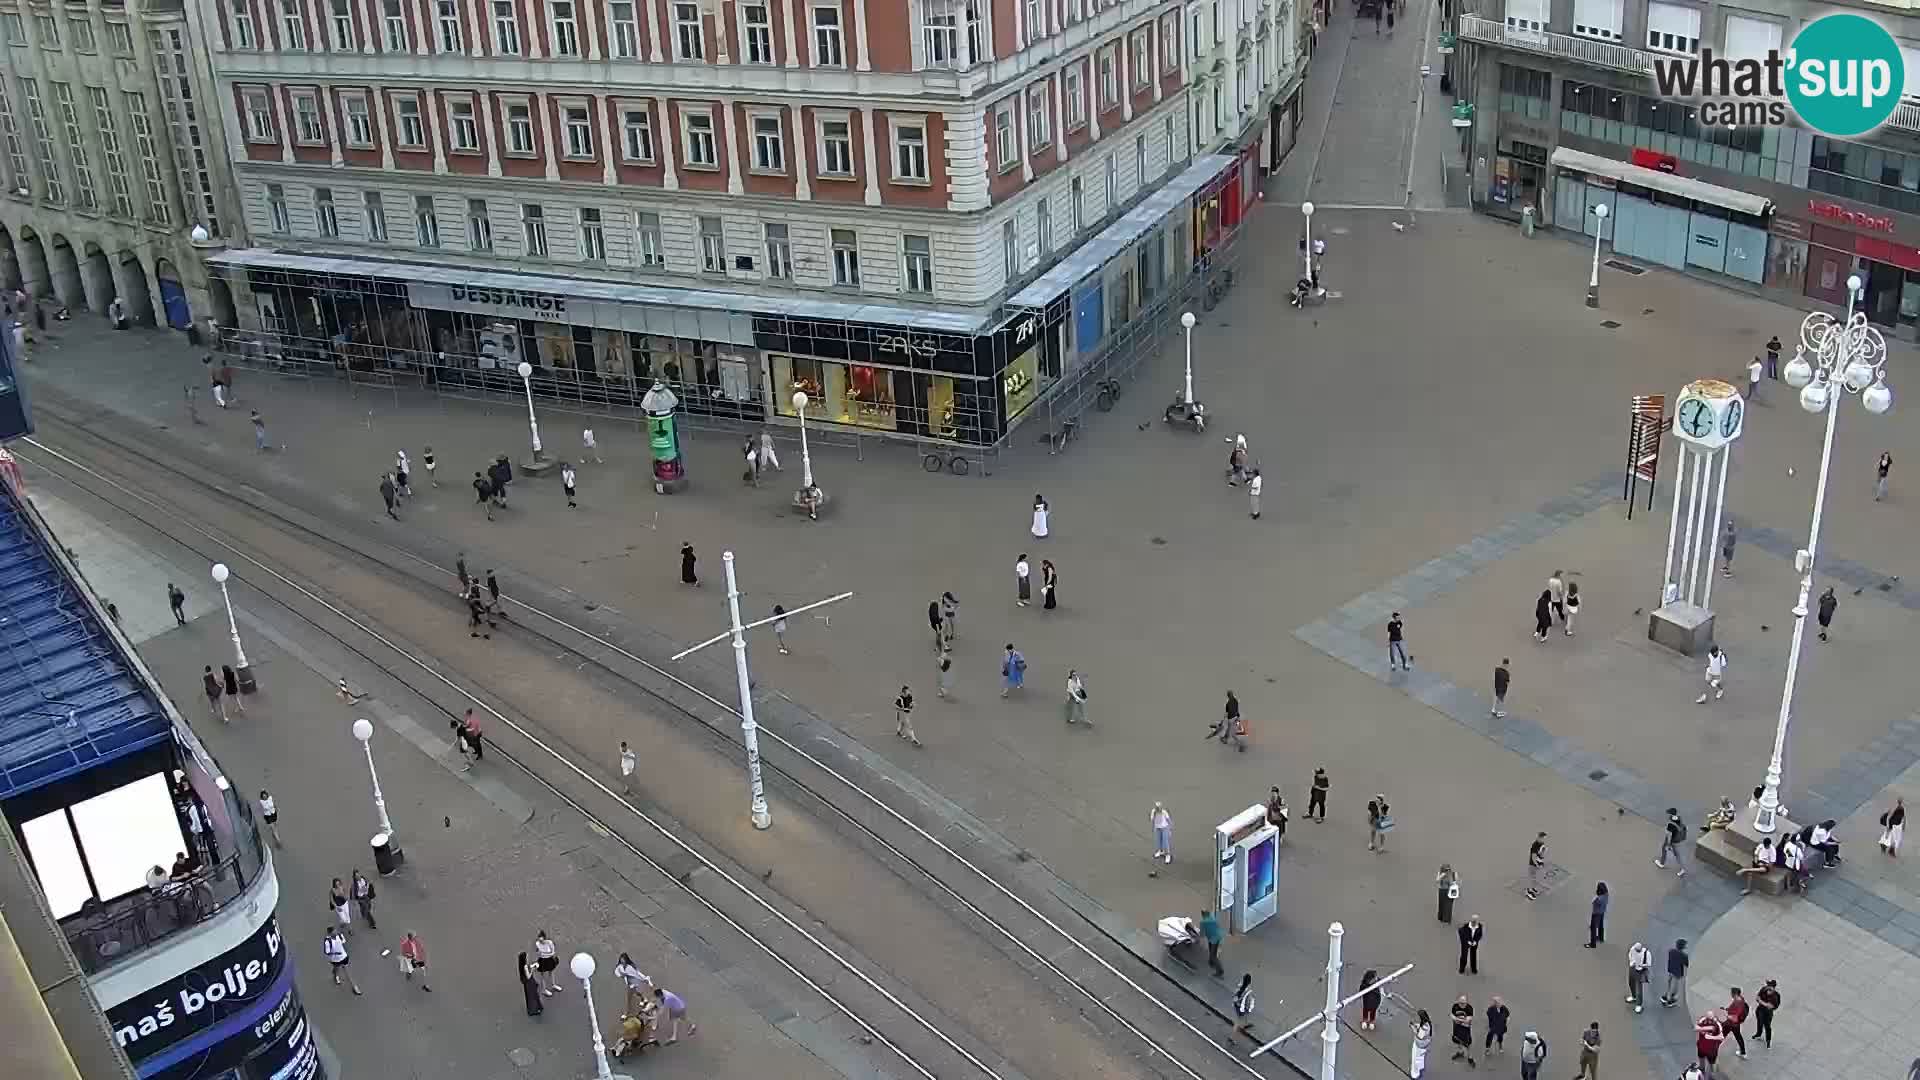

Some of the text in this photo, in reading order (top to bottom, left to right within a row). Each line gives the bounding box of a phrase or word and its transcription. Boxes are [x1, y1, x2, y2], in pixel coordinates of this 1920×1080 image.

[1856, 212, 1896, 233] Bank
[452, 285, 566, 312] DESSANGE
[877, 334, 937, 356] ZAKS
[115, 999, 175, 1047] naš
[179, 959, 268, 1016] bolje,
